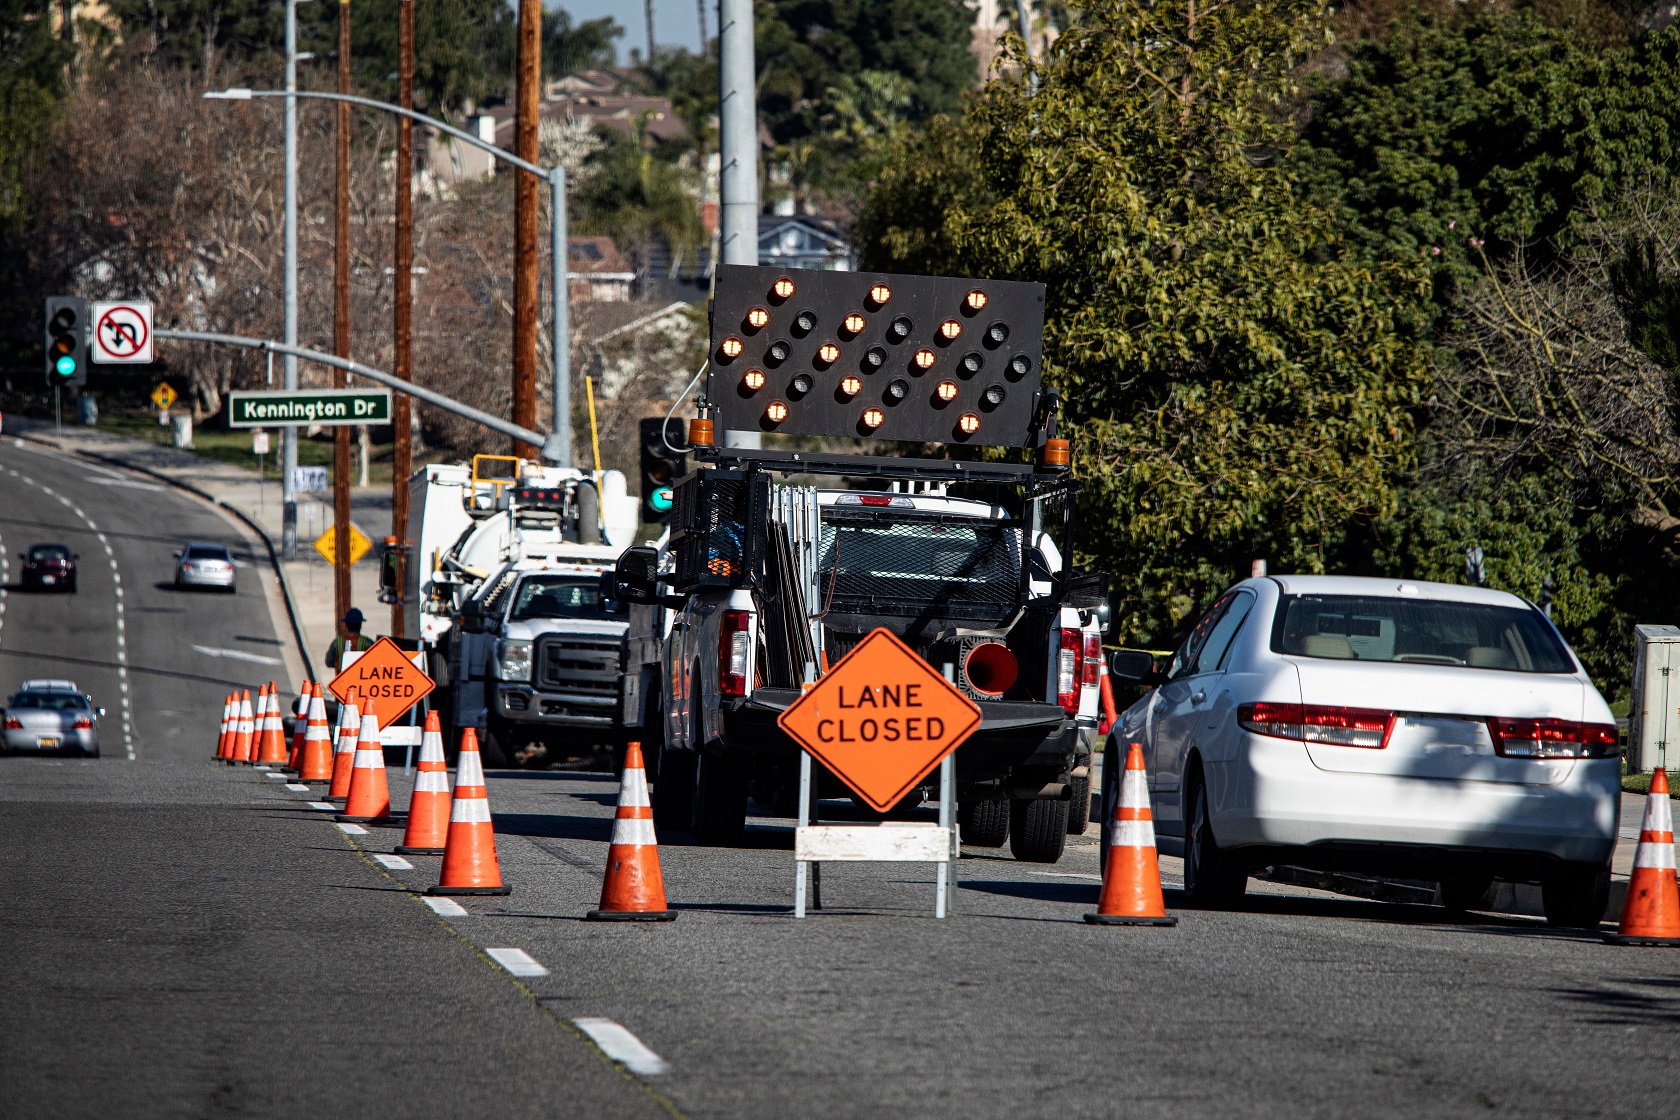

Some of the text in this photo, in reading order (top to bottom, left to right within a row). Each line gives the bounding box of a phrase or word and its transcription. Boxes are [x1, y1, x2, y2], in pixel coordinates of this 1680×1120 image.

[244, 399, 377, 421] Kennington Dr
[360, 667, 404, 680] LANE
[838, 684, 923, 709] LANE
[817, 717, 945, 742] CLOSED
